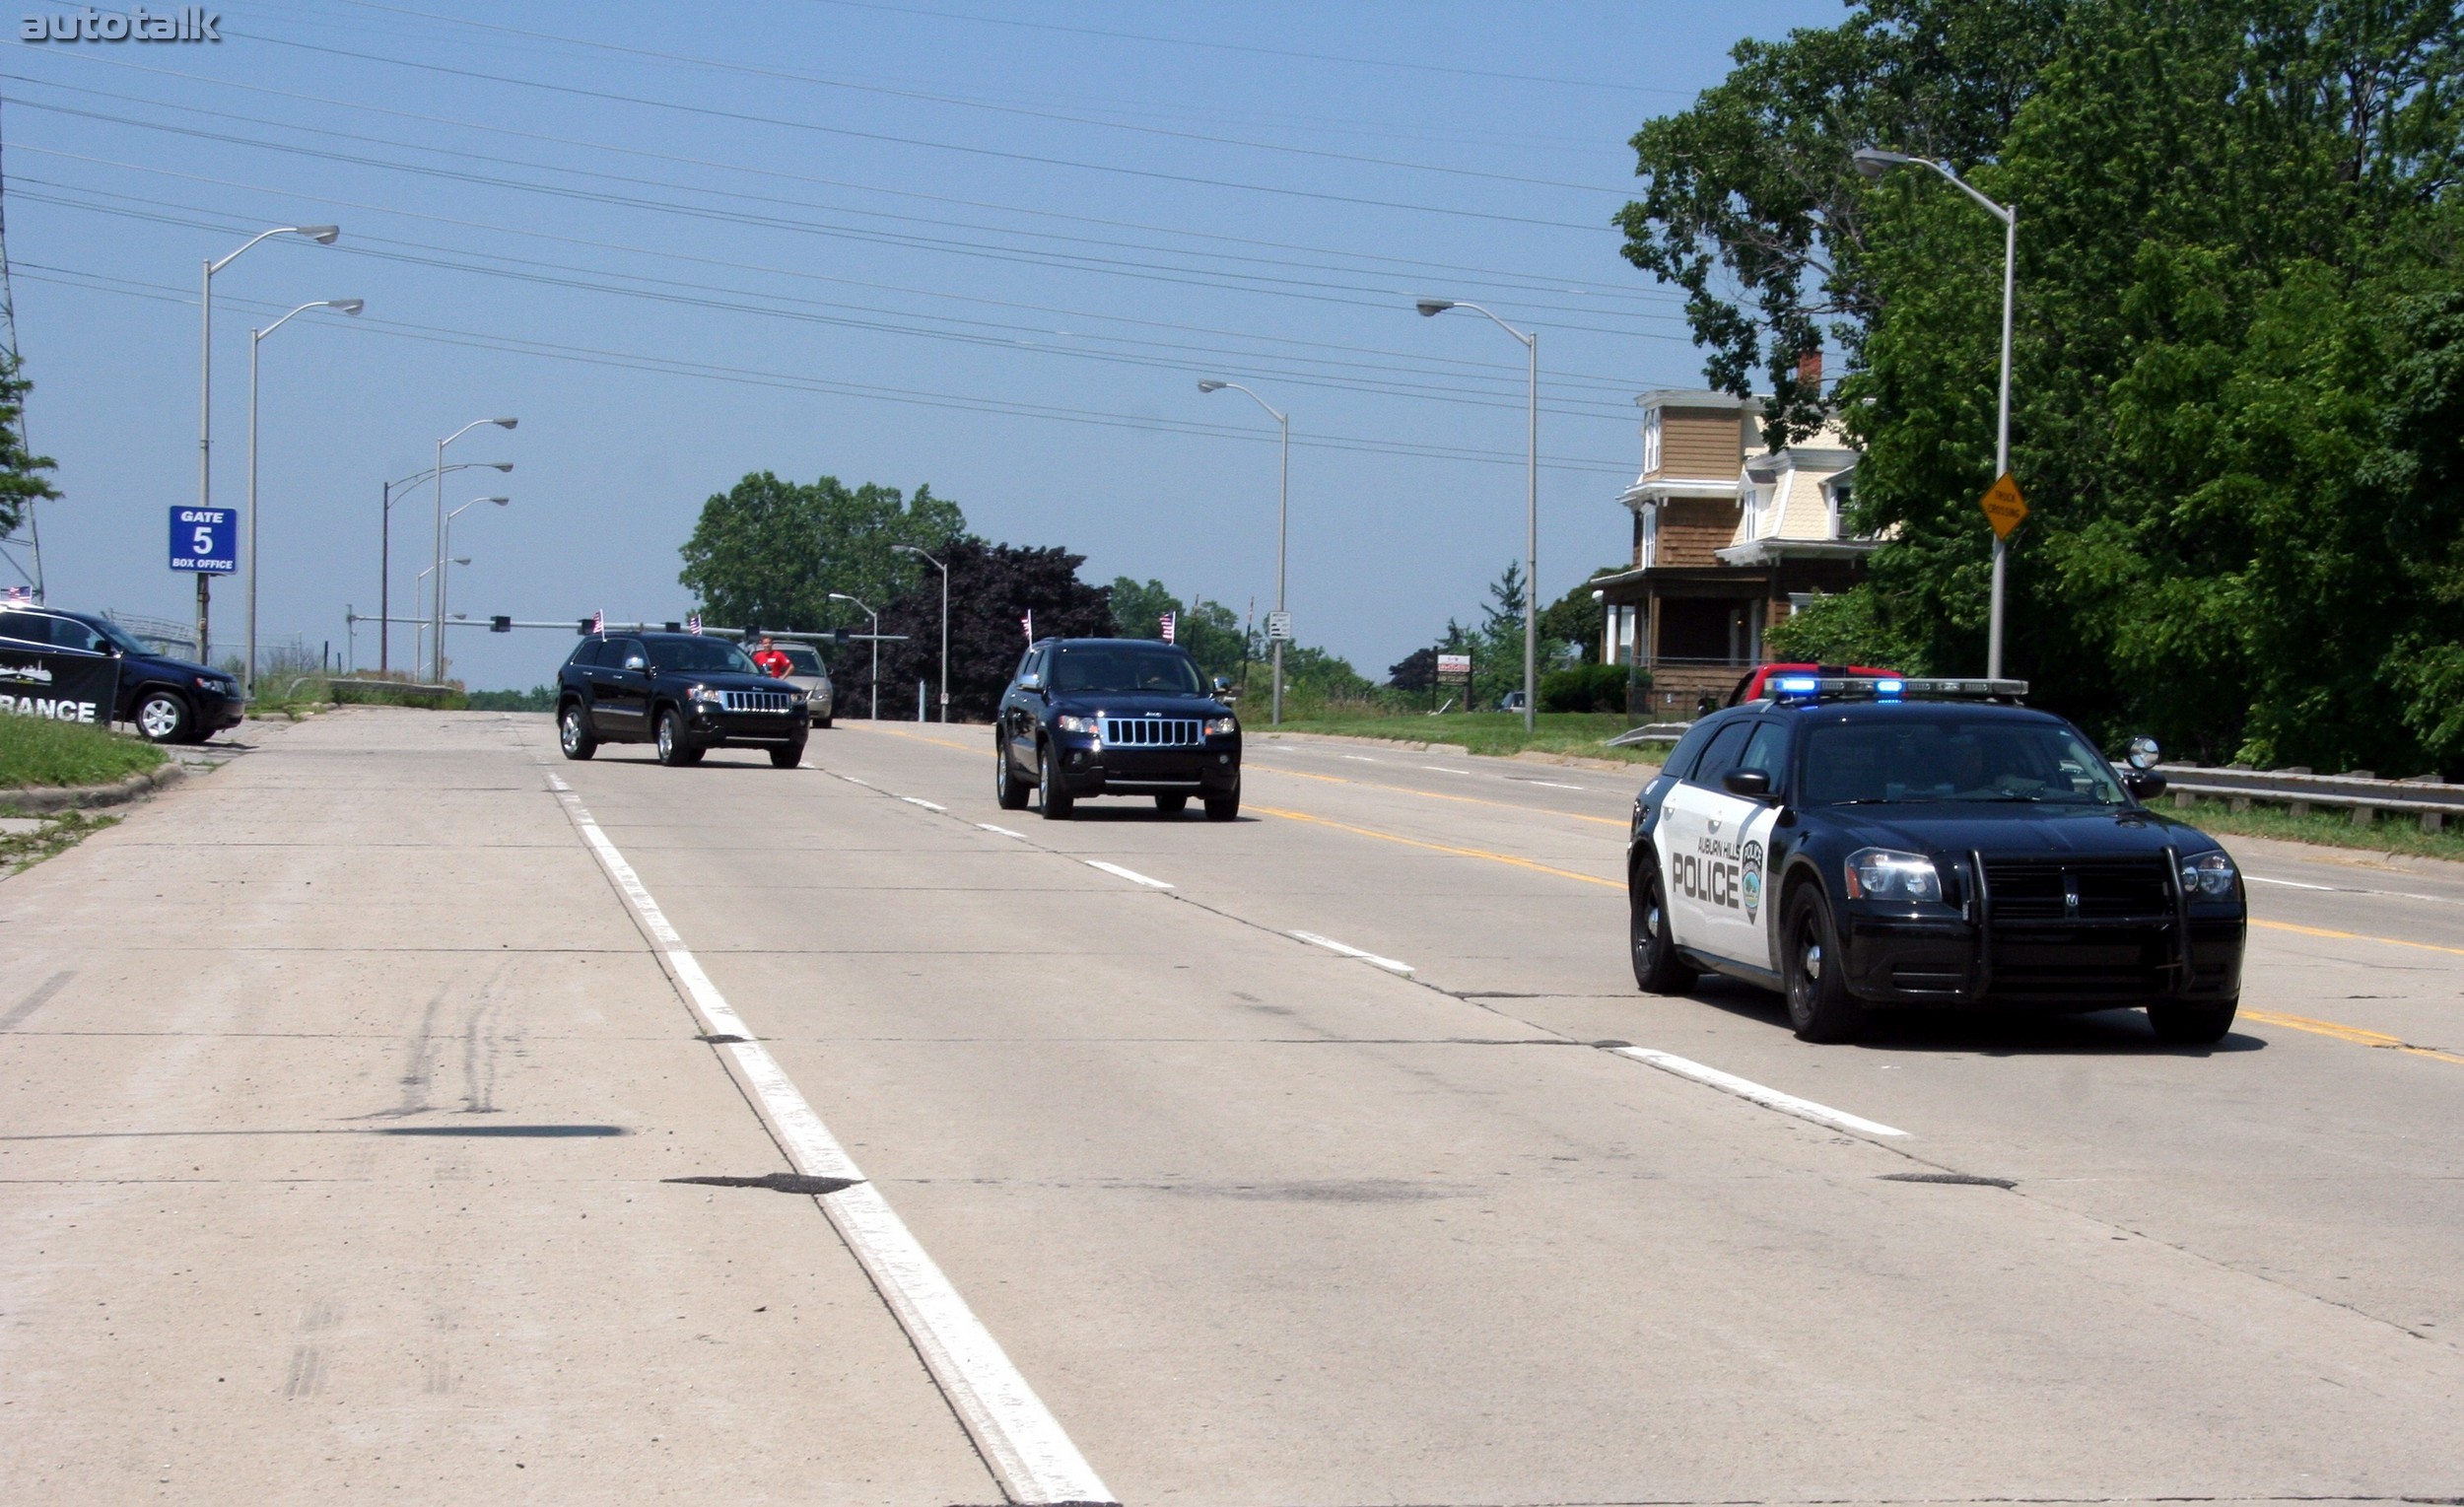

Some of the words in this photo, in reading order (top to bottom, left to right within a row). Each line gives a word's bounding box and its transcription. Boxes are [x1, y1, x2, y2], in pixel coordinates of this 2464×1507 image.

[180, 511, 224, 523] GATE
[193, 526, 213, 555] 5
[172, 558, 195, 568] BOX
[197, 559, 233, 569] OFFICE
[1698, 837, 1723, 857] AUBURN
[1723, 841, 1741, 861] HILLS
[1744, 843, 1762, 867] POLICE
[1673, 853, 1740, 909] POLICE
